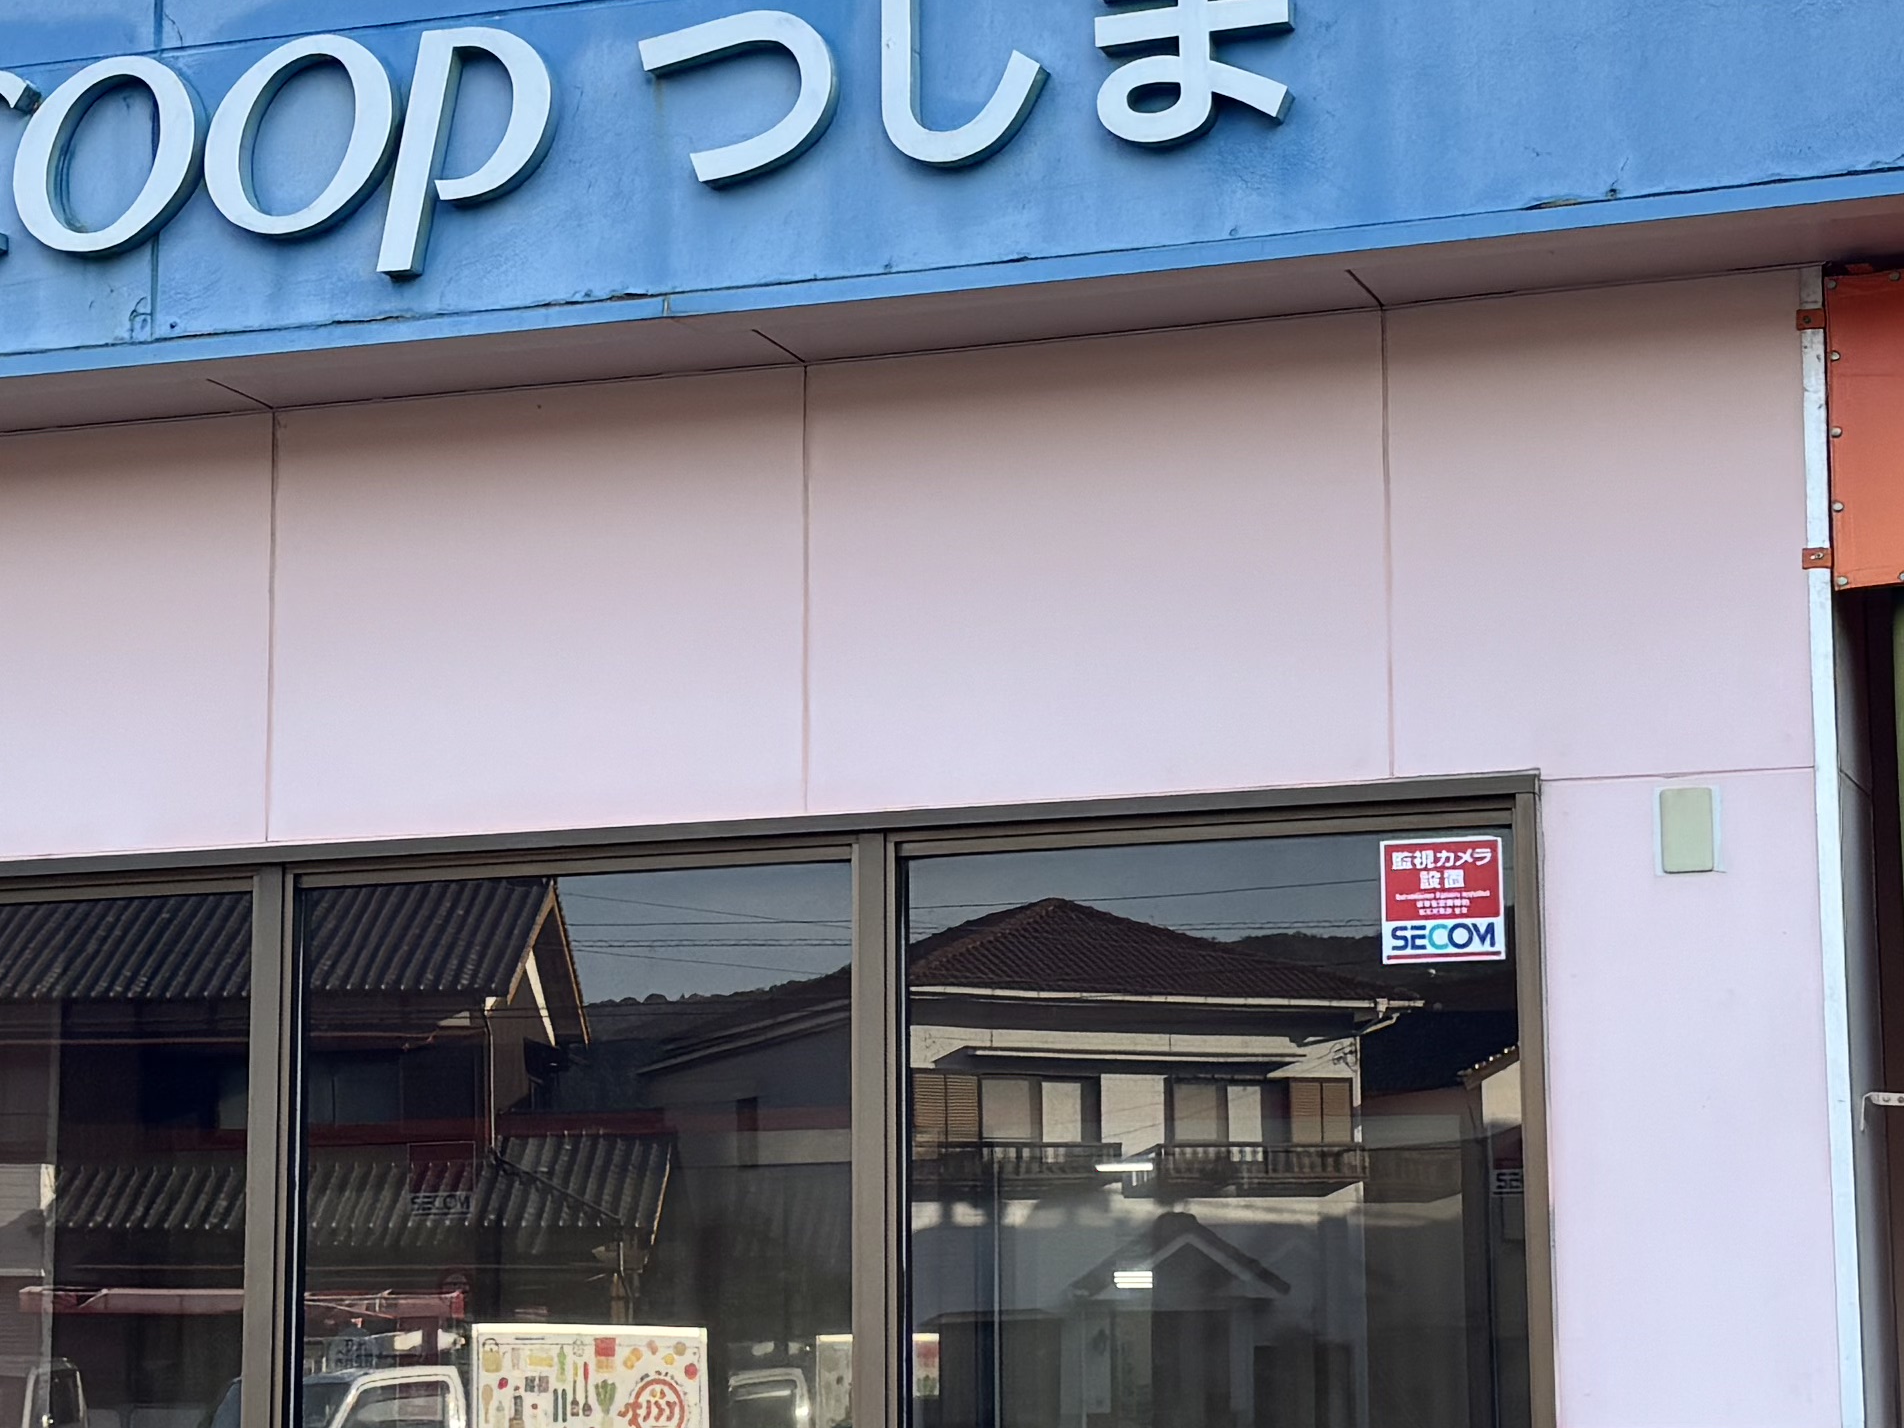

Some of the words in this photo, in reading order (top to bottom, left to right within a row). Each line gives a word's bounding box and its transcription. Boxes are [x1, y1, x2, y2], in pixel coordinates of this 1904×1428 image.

[1391, 848, 1493, 871] 監視カメラ
[1391, 922, 1496, 952] SECOM
